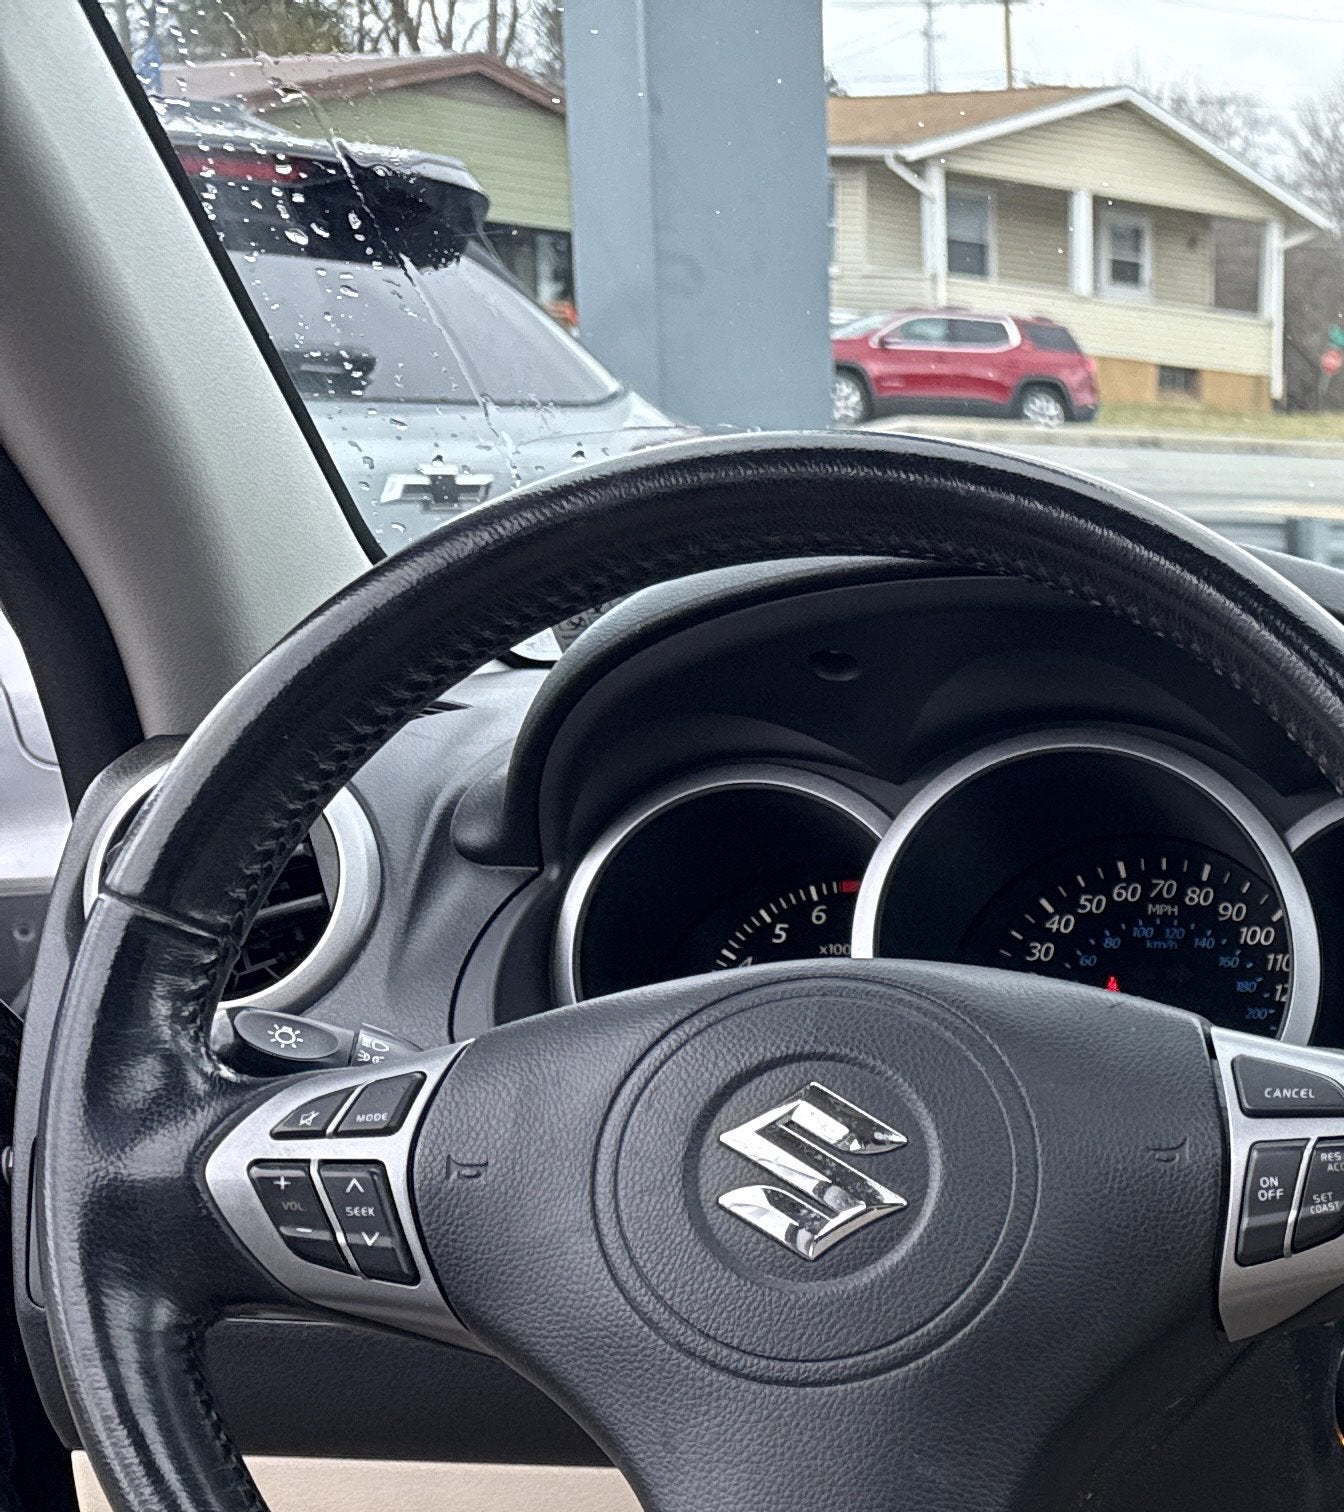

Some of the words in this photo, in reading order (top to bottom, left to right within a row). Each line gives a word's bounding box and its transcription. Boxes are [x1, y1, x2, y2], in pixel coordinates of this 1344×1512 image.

[1112, 882, 1142, 902] 60
[1150, 879, 1177, 898] 70
[1184, 886, 1214, 906] 80
[1077, 894, 1107, 914] 50
[1147, 904, 1178, 916] MPH
[811, 905, 827, 925] 6
[1218, 902, 1247, 922] 90
[1045, 914, 1075, 934] 40
[771, 923, 789, 943] 5
[1164, 927, 1185, 939] 120
[1239, 925, 1275, 946] 100
[1193, 937, 1215, 949] 140
[1025, 941, 1055, 961] 30
[1218, 956, 1240, 968] 160
[1245, 1007, 1268, 1020] 200
[1264, 1087, 1316, 1099] CANCEL
[355, 1112, 389, 1123] MODE
[1320, 1151, 1342, 1162] RES
[1260, 1176, 1279, 1188] ON
[1257, 1188, 1285, 1201] OFF
[1312, 1191, 1334, 1203] SET
[281, 1201, 305, 1212] VOL
[345, 1206, 376, 1217] SEEK
[1309, 1201, 1341, 1214] COAST
